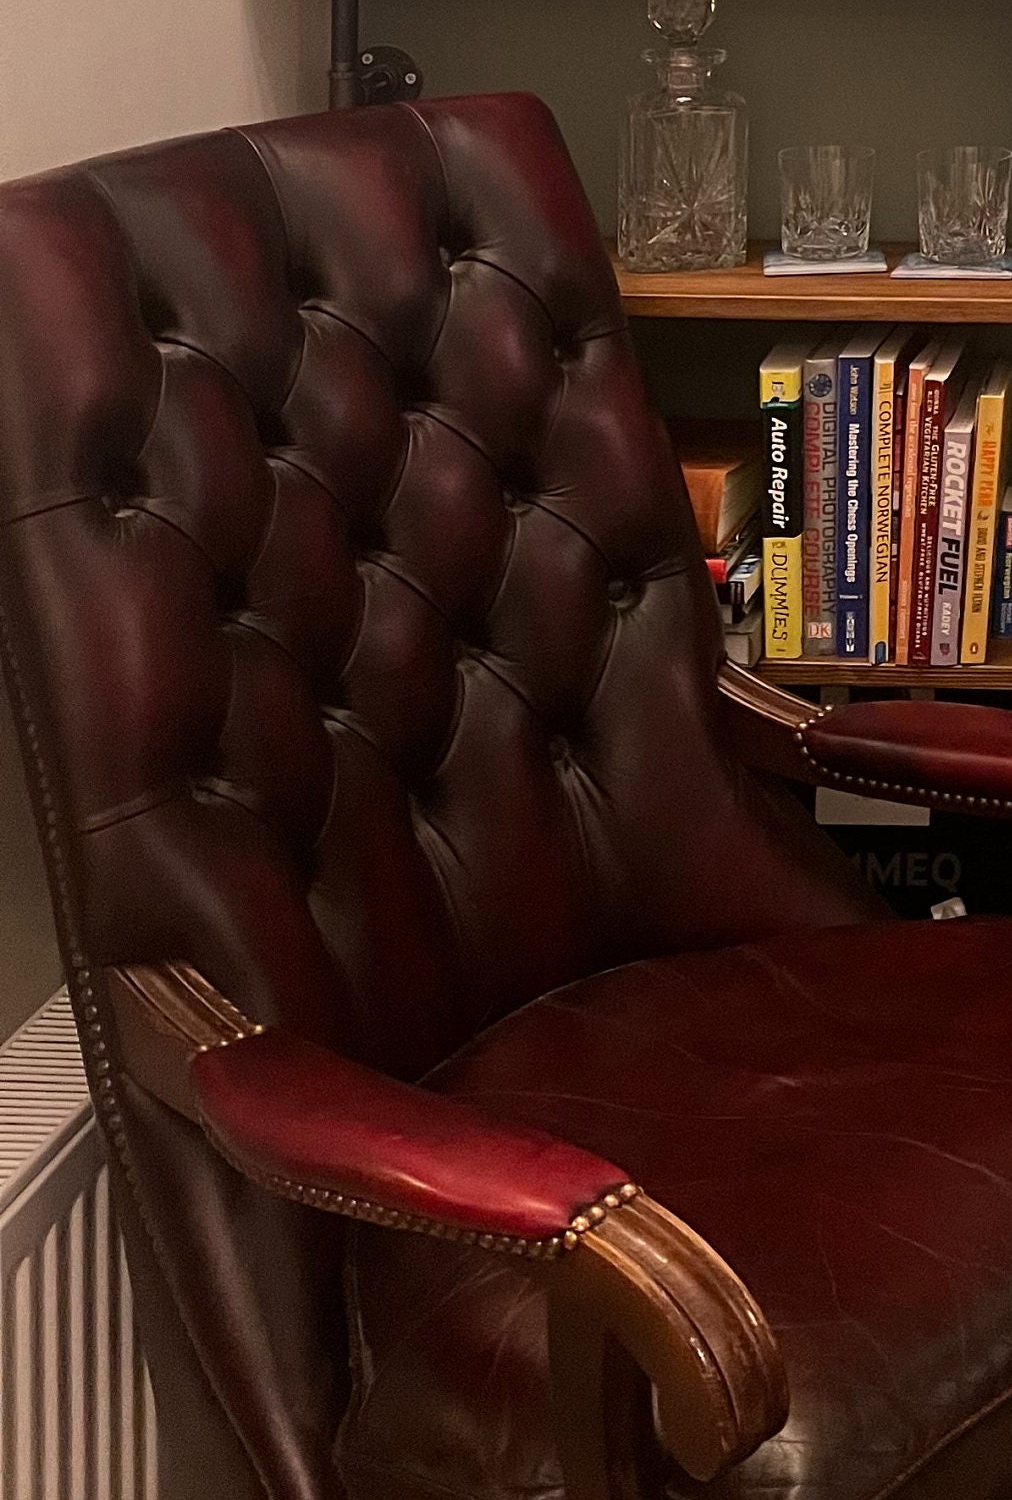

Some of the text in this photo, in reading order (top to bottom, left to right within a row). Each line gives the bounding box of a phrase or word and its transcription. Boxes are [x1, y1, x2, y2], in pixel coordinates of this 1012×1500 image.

[850, 364, 860, 385] John
[768, 417, 790, 529] Auto Repair
[846, 423, 860, 477] Mastering
[920, 416, 933, 515] VEGETARIAN KITCHEN
[928, 444, 940, 507] GLUTEN-FREE
[980, 441, 997, 475] HAPPY
[803, 402, 821, 617] COMPLETE COURSE
[821, 402, 837, 614] DIGITAL PHOTOGRAPHY
[847, 480, 859, 497] the
[847, 499, 859, 531] Chess
[876, 401, 892, 583] COMPLETE NORWEGIAN
[844, 533, 859, 583] Openings
[937, 441, 967, 636] ROCKET FUEL KADEY
[975, 547, 987, 562] AND
[770, 554, 790, 641] DUMMIES
[1003, 552, 1012, 599] Norwegian
[809, 624, 831, 637] DK
